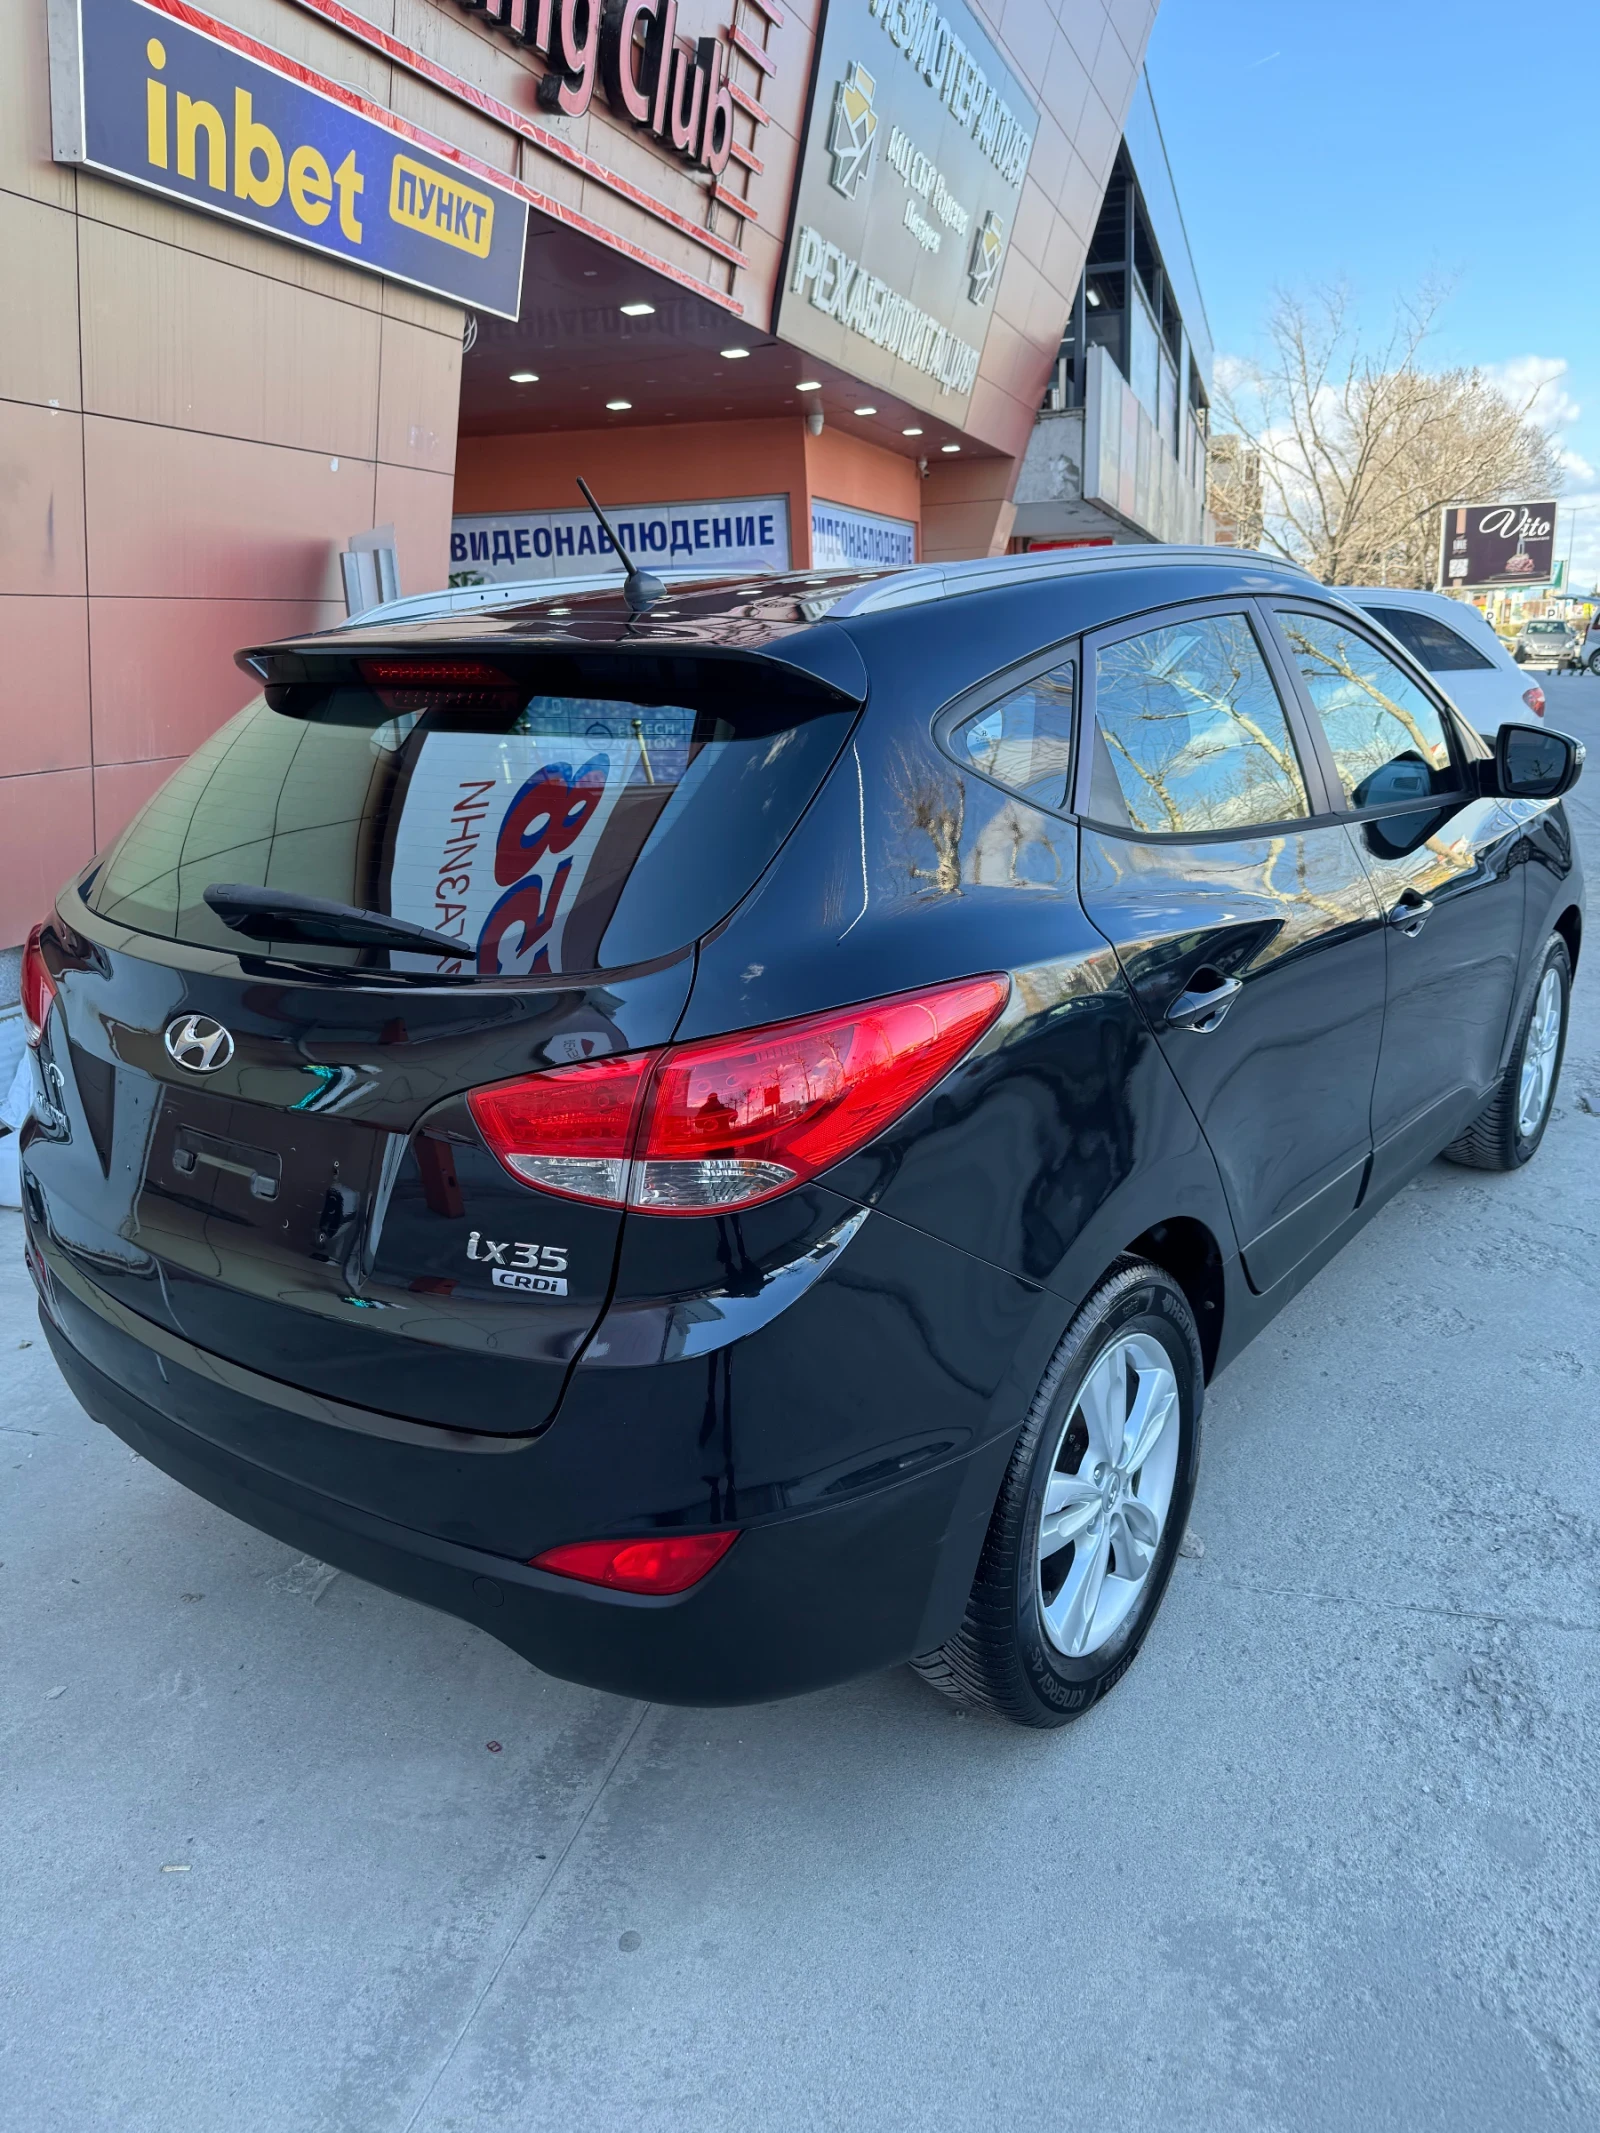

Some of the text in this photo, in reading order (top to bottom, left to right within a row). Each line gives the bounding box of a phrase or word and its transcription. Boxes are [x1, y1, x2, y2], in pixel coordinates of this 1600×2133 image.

[617, 0, 733, 176] Club
[868, 0, 1032, 190] ЗИОТЕРАПИЯ
[146, 38, 364, 245] inbet
[397, 170, 487, 246] ПУНКТ
[791, 226, 980, 396] РЕХАБИЛИТАЦИЯ
[450, 514, 775, 566] ВИДЕОНАБЛЮДЕНИЕ
[1479, 506, 1550, 538] Vito
[466, 1231, 568, 1272] ix35
[499, 1273, 558, 1292] CRDi
